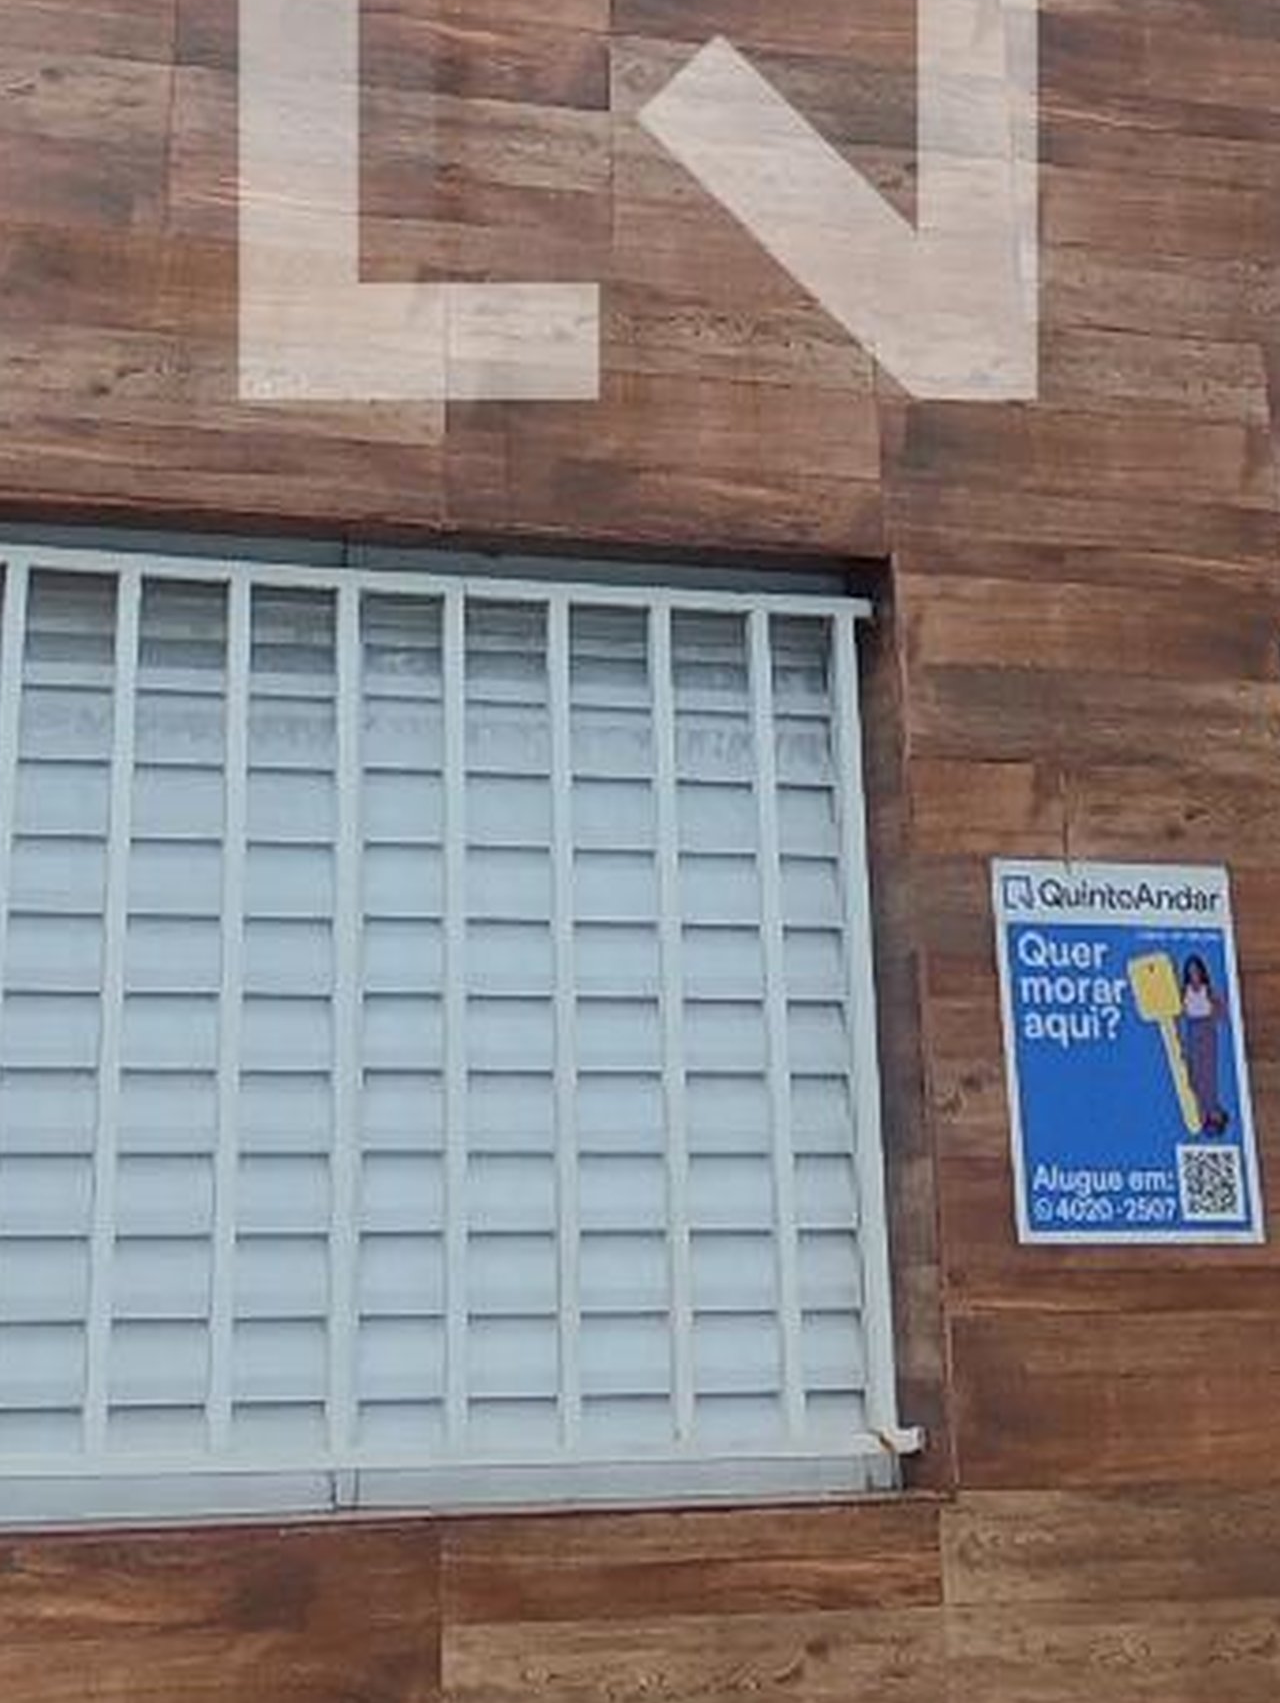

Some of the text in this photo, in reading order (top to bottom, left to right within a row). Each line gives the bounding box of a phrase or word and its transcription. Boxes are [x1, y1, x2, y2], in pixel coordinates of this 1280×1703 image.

[1038, 879, 1221, 912] QuintoAndar
[1018, 931, 1109, 970] Quer
[1021, 975, 1127, 1006] morar
[1024, 1005, 1121, 1049] aqui?
[1033, 1164, 1176, 1197] Alugue em:
